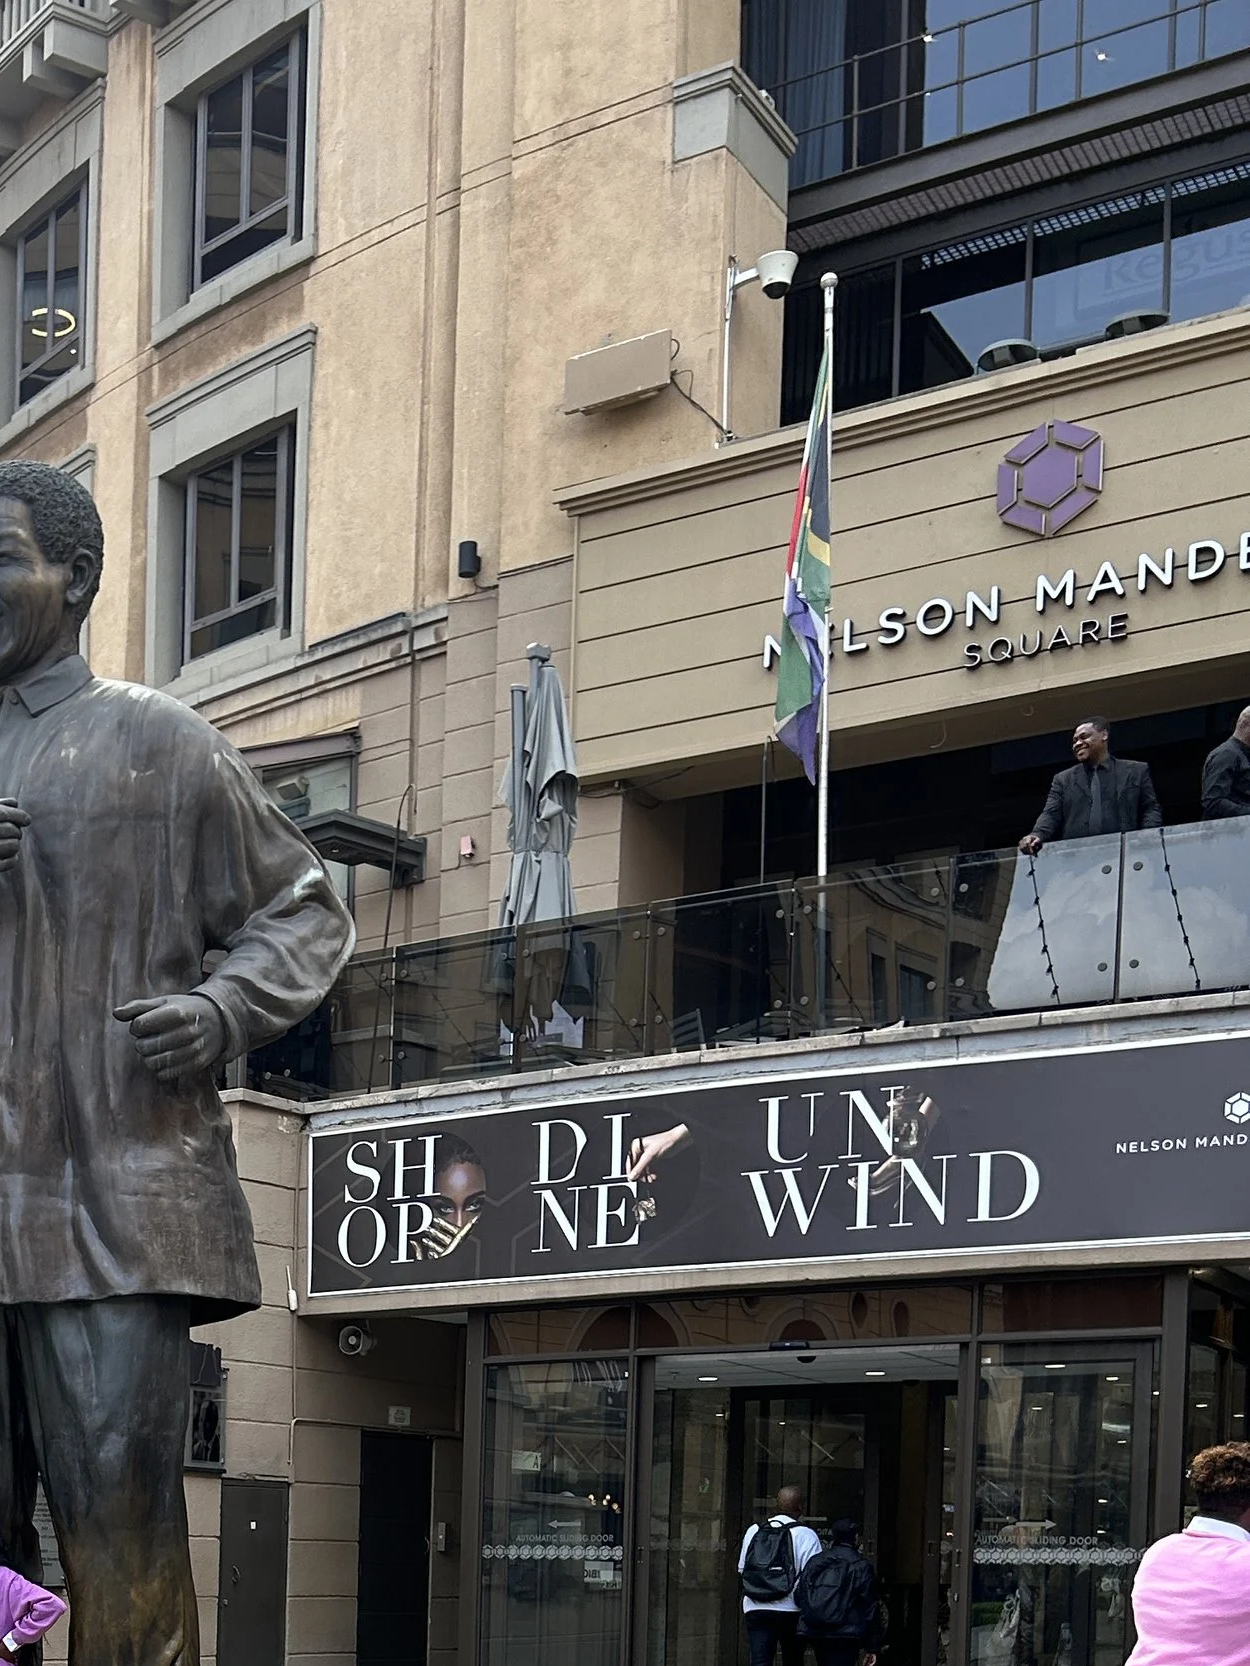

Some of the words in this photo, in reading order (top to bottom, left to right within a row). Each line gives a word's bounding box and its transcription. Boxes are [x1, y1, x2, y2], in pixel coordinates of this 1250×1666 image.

[763, 585, 1000, 669] NLSON
[964, 612, 1129, 668] SQUARE
[1115, 1138, 1187, 1154] NELSON
[1195, 1133, 1248, 1149] MAND
[741, 1149, 1041, 1238] WIND
[516, 1534, 557, 1543] AUTOMATIC
[559, 1534, 588, 1543] SLIDING
[590, 1534, 614, 1543] DOOR
[1070, 1536, 1099, 1546] DOOR
